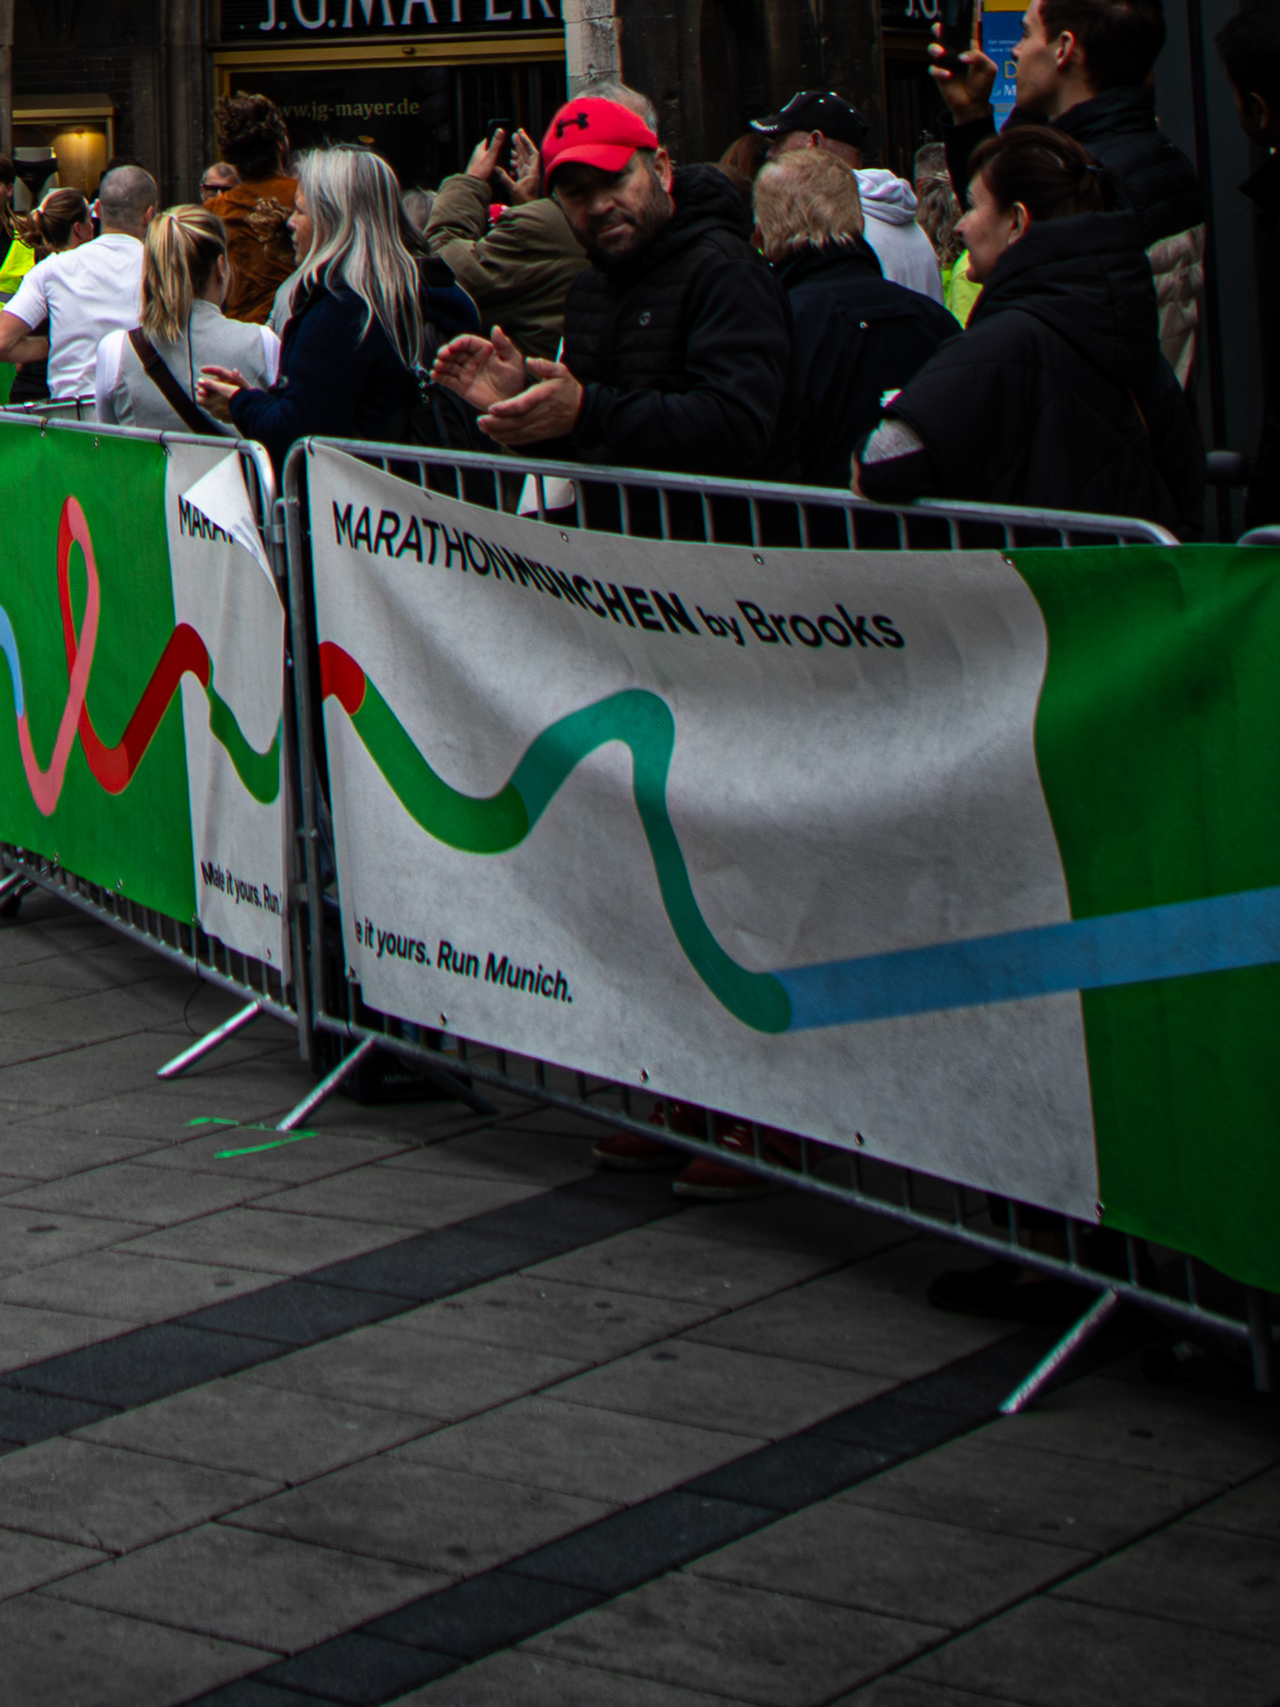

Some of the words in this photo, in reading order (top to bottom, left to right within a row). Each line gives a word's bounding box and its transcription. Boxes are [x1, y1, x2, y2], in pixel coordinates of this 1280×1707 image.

[695, 605, 745, 648] by
[737, 600, 906, 650] Brooks
[263, 882, 280, 916] Run
[364, 917, 374, 949] it
[376, 927, 432, 967] yours.
[437, 939, 481, 979] Run
[484, 951, 574, 1004] Munich.
